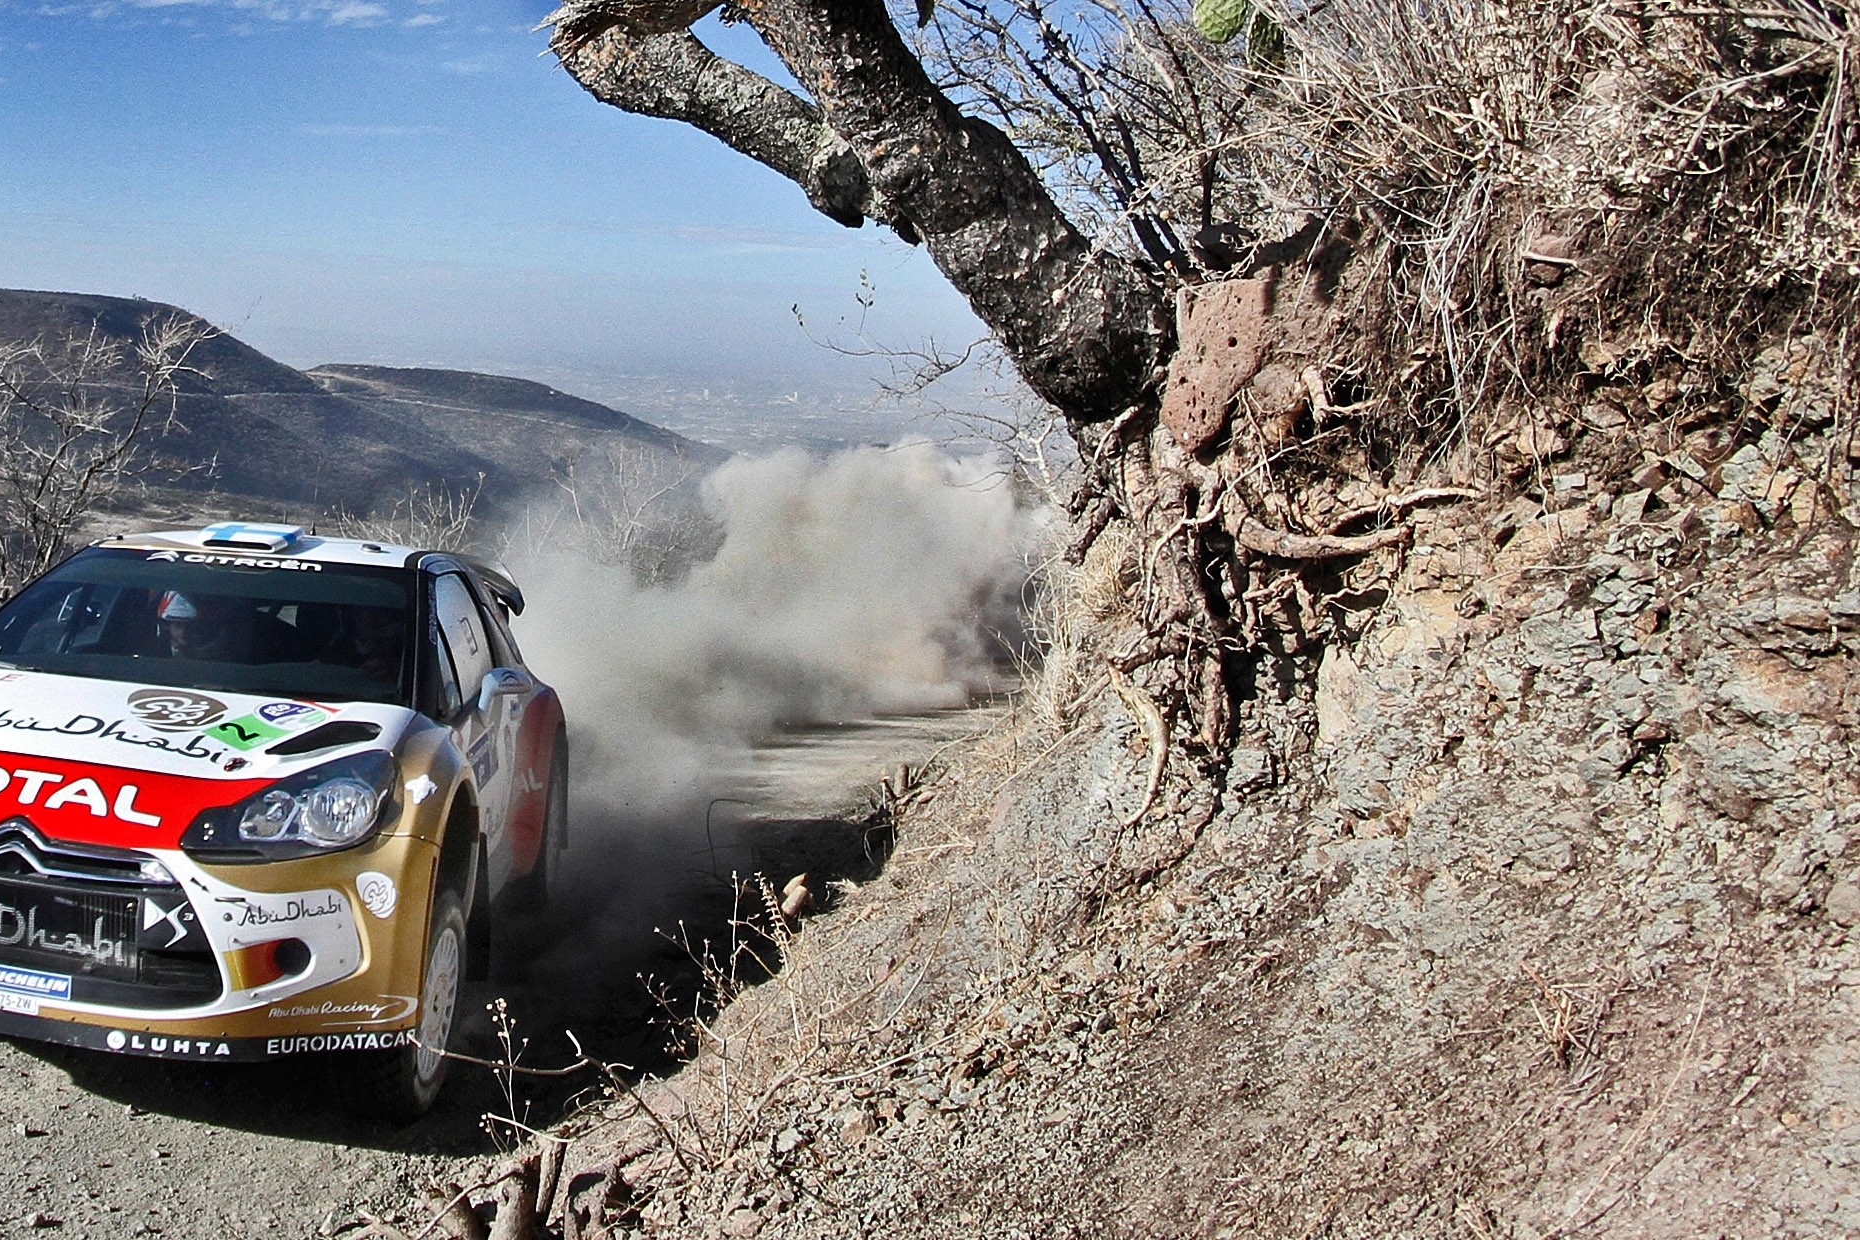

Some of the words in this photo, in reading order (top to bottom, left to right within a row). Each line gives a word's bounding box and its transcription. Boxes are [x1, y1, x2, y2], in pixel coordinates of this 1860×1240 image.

[218, 722, 260, 742] 2
[268, 1007, 290, 1018] Abu
[290, 1004, 319, 1017] Dhabi
[320, 1000, 402, 1019] Racing
[131, 1035, 231, 1056] LUHTA
[267, 1028, 416, 1054] EURODATACAR
